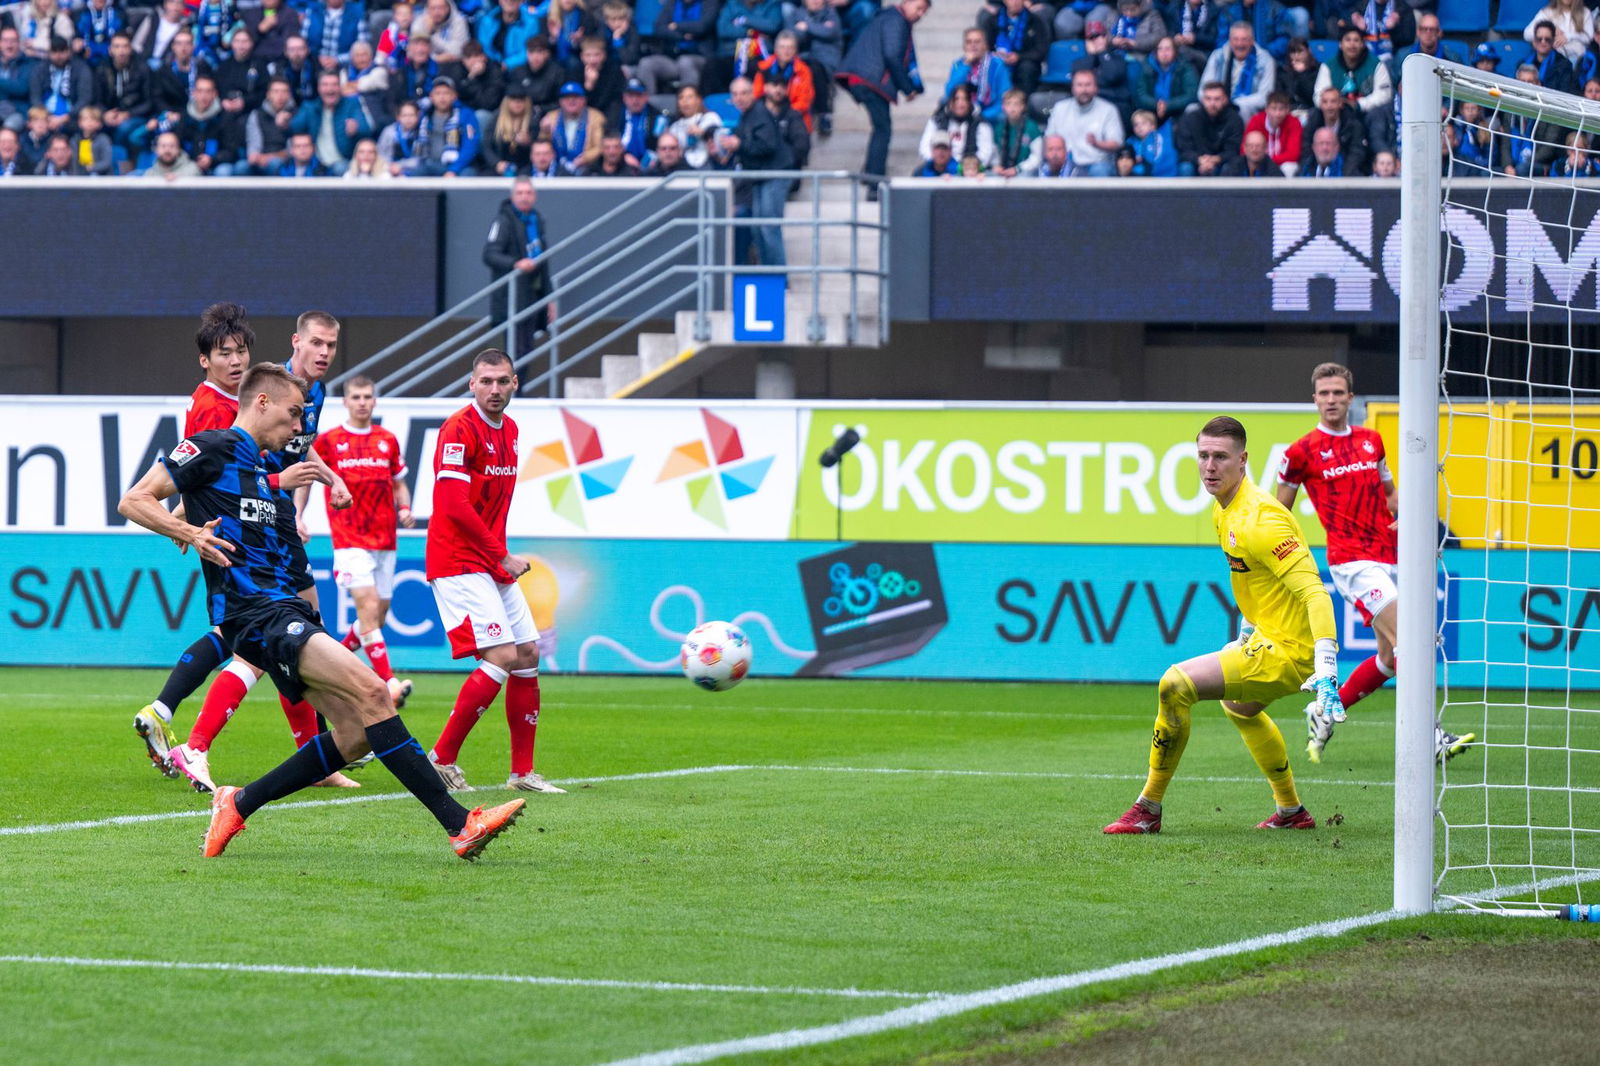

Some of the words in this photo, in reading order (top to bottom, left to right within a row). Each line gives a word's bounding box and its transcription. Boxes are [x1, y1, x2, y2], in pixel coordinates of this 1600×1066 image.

[744, 283, 774, 332] L
[1541, 436, 1598, 480] 10
[9, 566, 200, 630] SAVV
